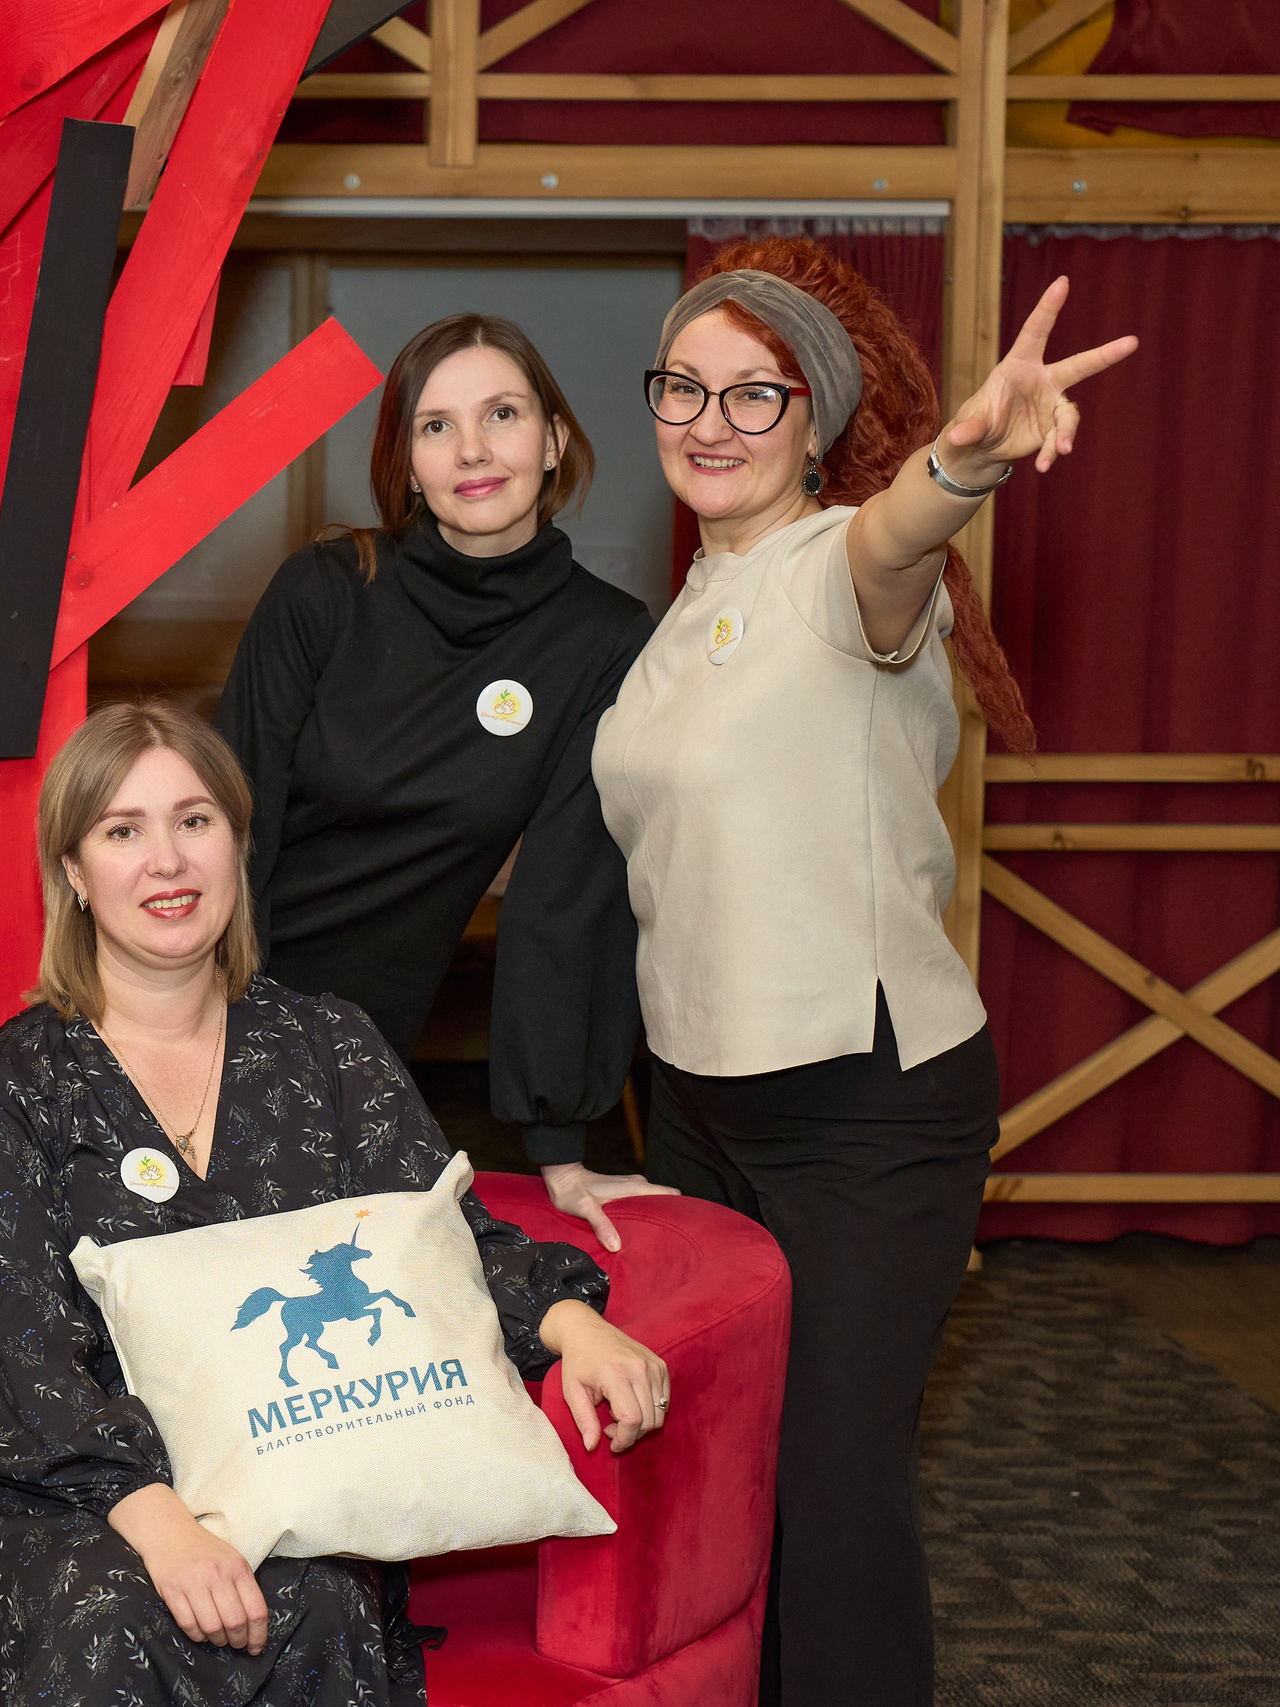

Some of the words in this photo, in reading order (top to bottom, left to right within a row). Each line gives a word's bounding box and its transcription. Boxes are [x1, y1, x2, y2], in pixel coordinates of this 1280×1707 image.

[247, 1358, 469, 1439] МЕРКУРИЯ
[256, 1402, 427, 1456] БЛАГОТВОРИТЕЛЬНЫЙ
[433, 1394, 476, 1410] ФОНД
